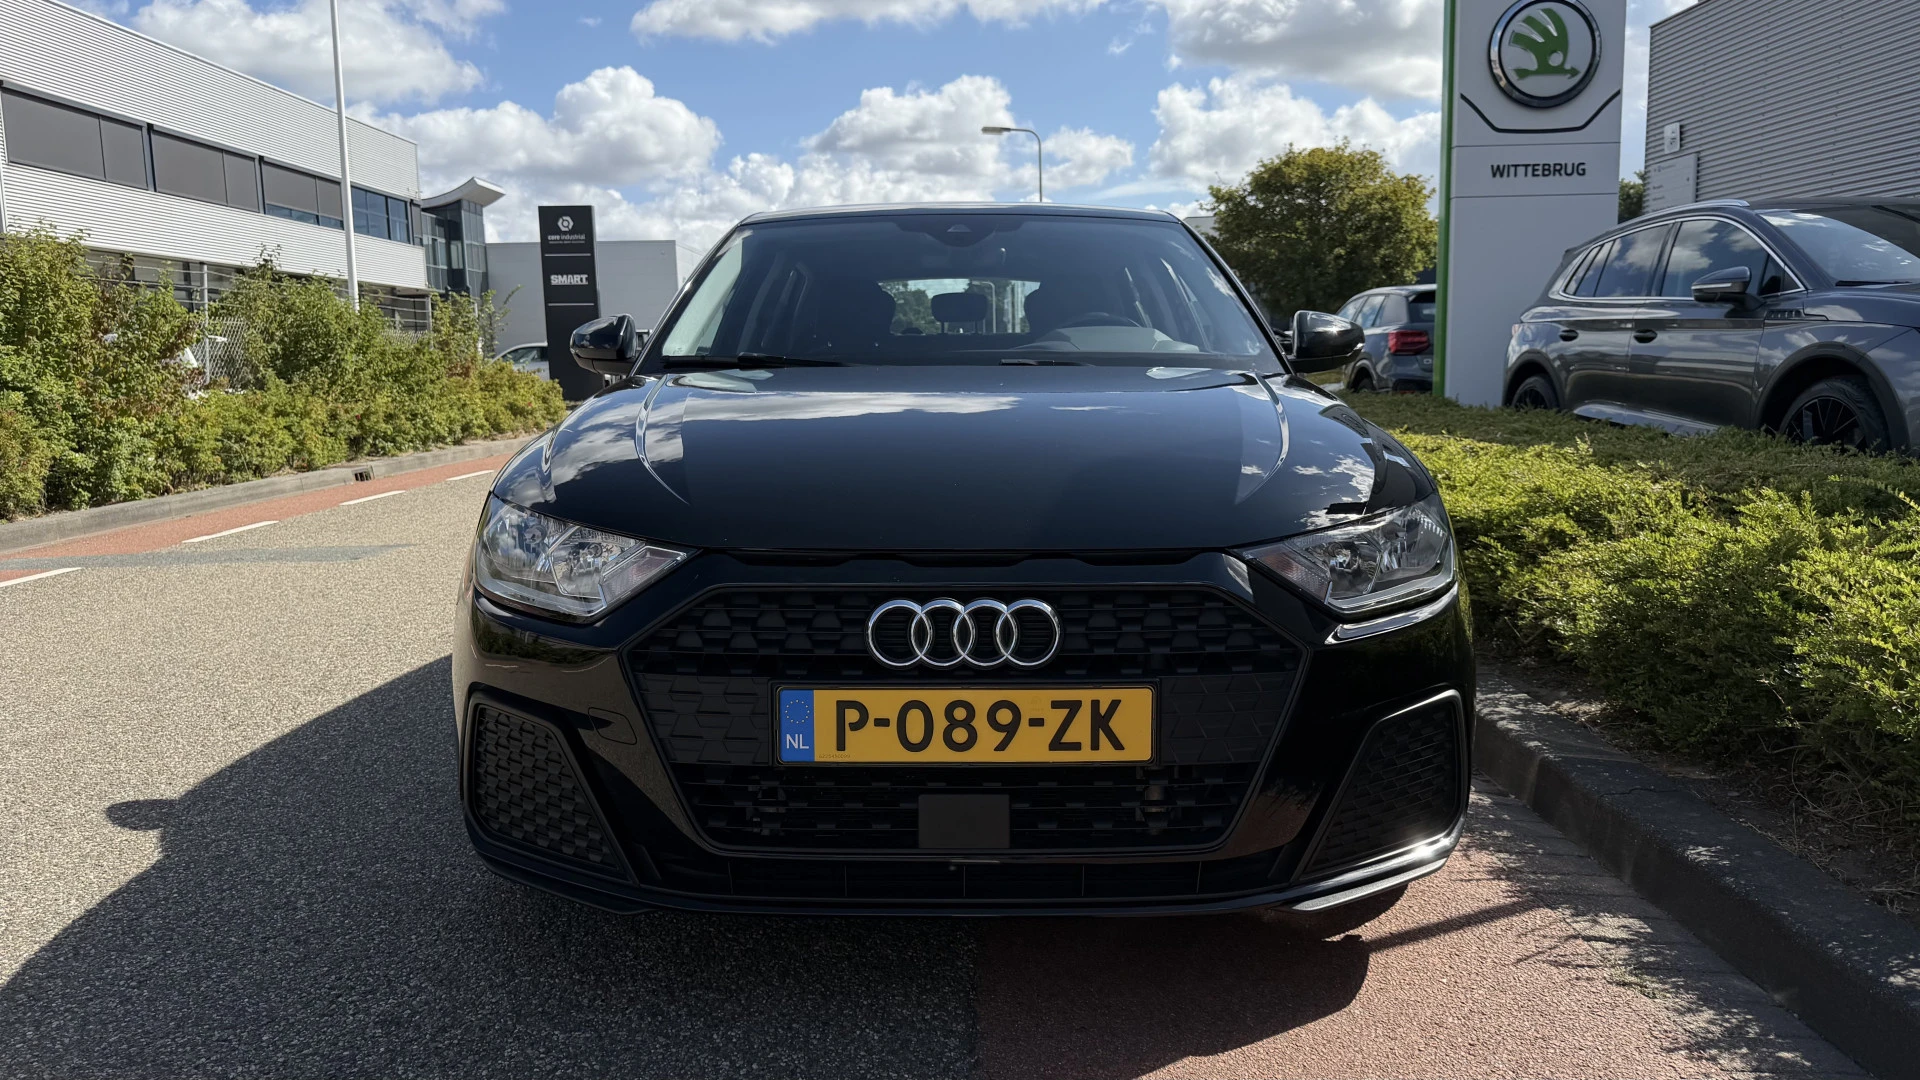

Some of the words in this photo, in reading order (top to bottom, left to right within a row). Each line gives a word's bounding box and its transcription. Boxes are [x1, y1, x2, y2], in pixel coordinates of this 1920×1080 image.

[1490, 162, 1586, 178] WITTEBRUG
[550, 274, 589, 285] SMART
[835, 699, 1126, 753] P-089-ZK
[785, 733, 810, 749] NL
